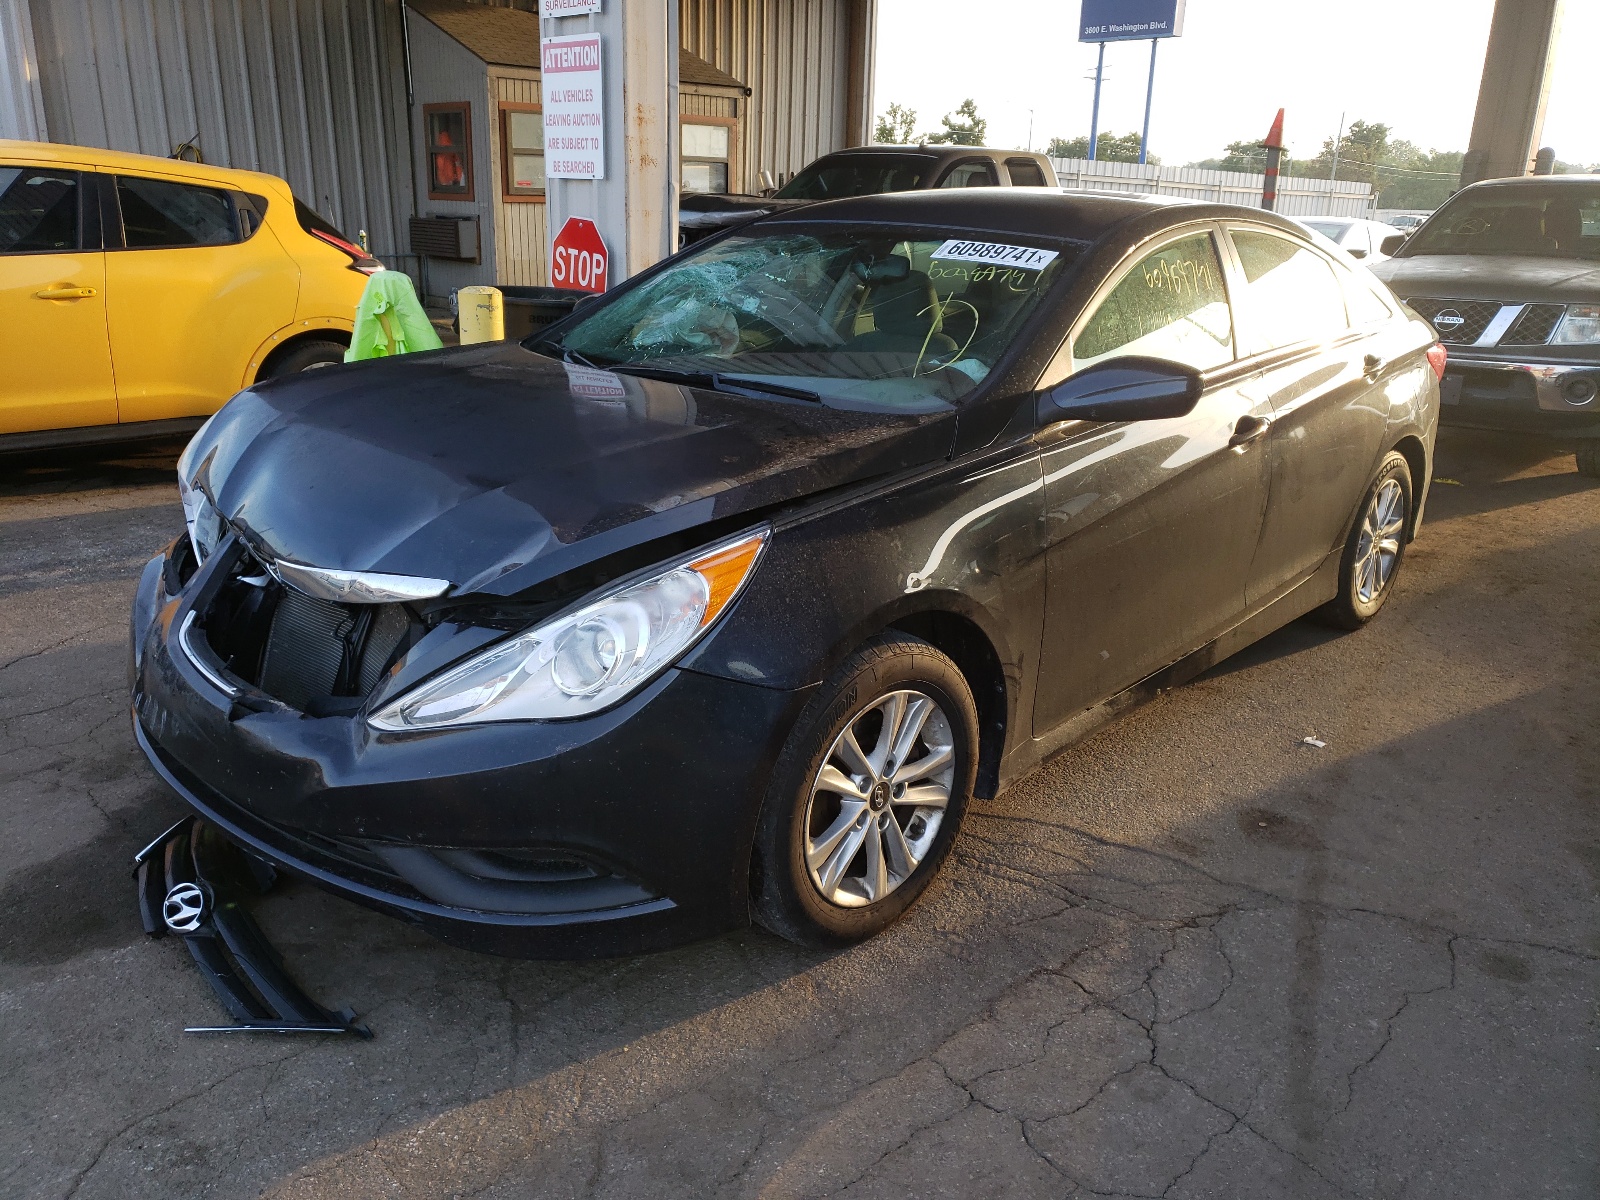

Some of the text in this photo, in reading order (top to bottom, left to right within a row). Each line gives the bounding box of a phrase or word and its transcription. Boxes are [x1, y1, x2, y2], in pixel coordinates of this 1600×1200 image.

[1101, 25, 1108, 33] E.
[1109, 23, 1149, 33] Washington
[1150, 21, 1168, 30] Blvd.
[544, 45, 598, 69] ATTENTION
[550, 89, 594, 103] ALL VEHICLES
[545, 113, 601, 127] LEAVING AUCTION
[548, 137, 599, 150] ARE SUBJECT TO
[553, 160, 595, 174] BE SEARCHED
[553, 245, 605, 288] STOP
